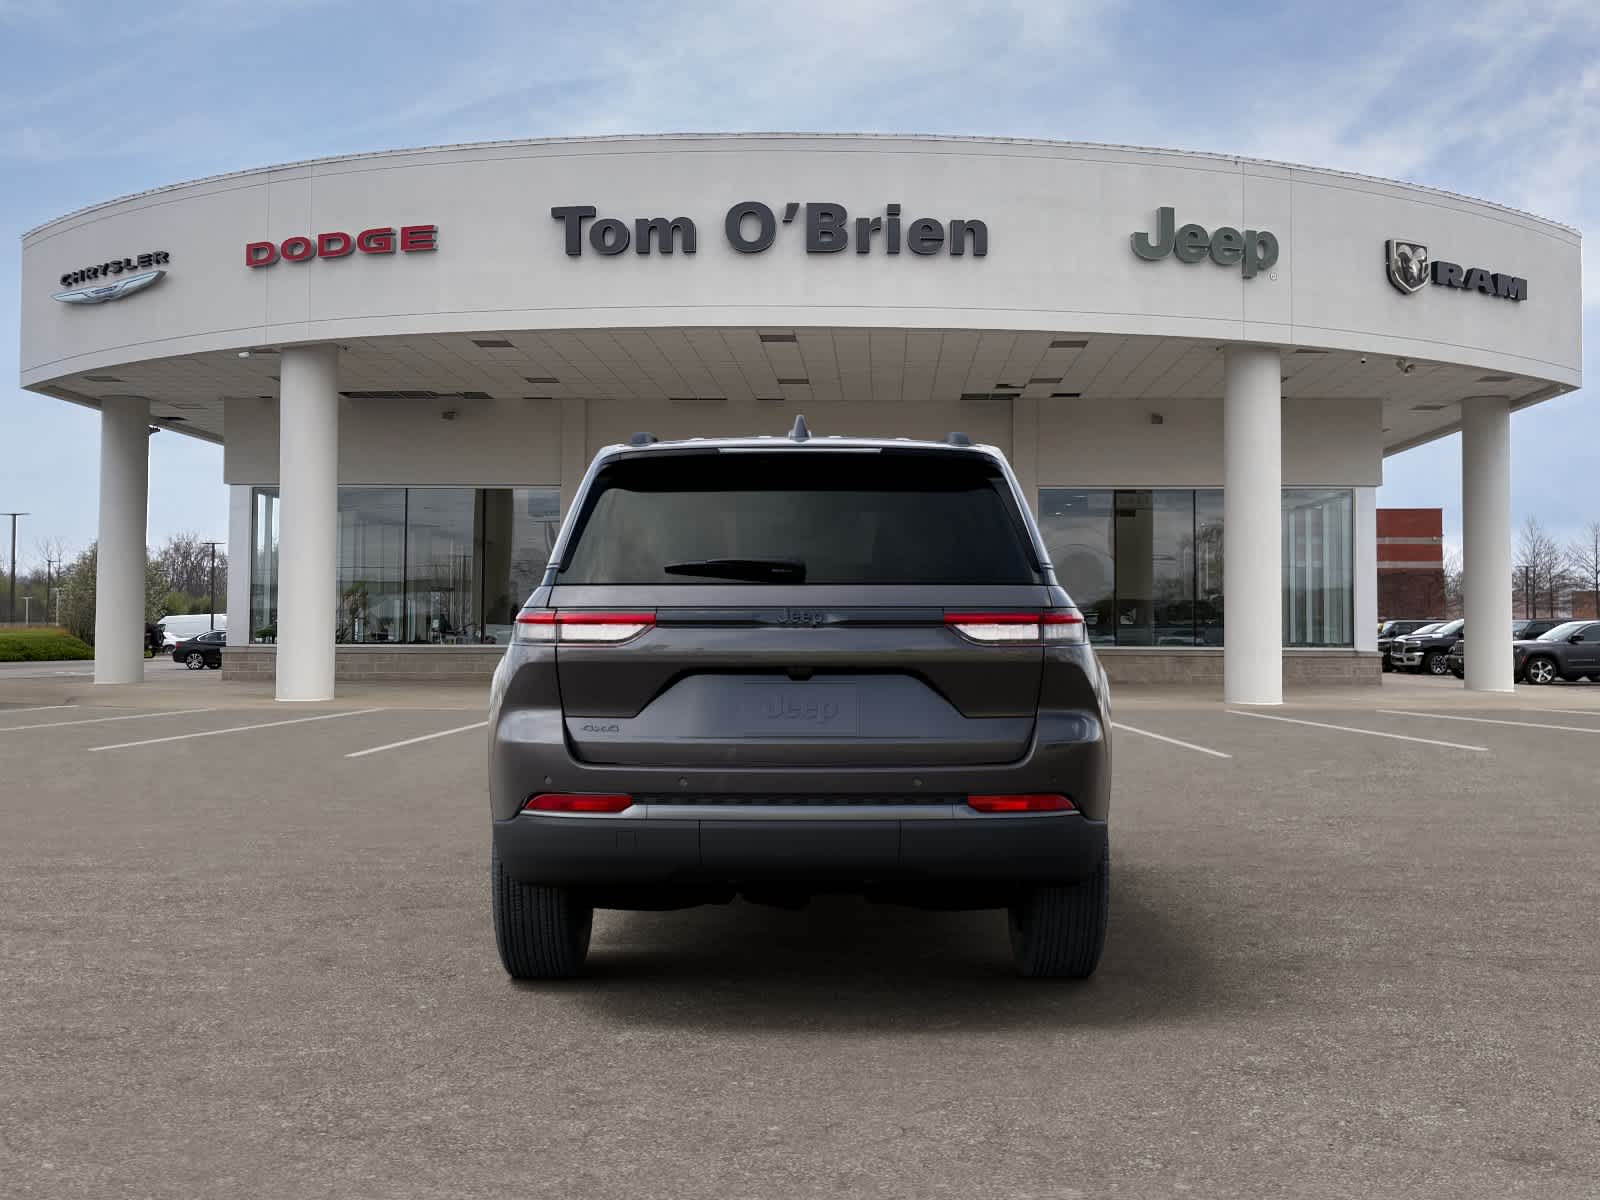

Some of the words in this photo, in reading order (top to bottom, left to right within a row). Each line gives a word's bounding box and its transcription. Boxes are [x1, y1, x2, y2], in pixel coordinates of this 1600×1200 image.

[246, 225, 437, 268] DODGE
[551, 205, 697, 257] Tom
[725, 201, 988, 256] O'Brien
[1131, 207, 1279, 279] Jeep
[60, 251, 169, 287] CHRYSLER
[1431, 261, 1527, 301] RAM
[776, 607, 825, 628] Jeep
[762, 695, 840, 728] Jeep
